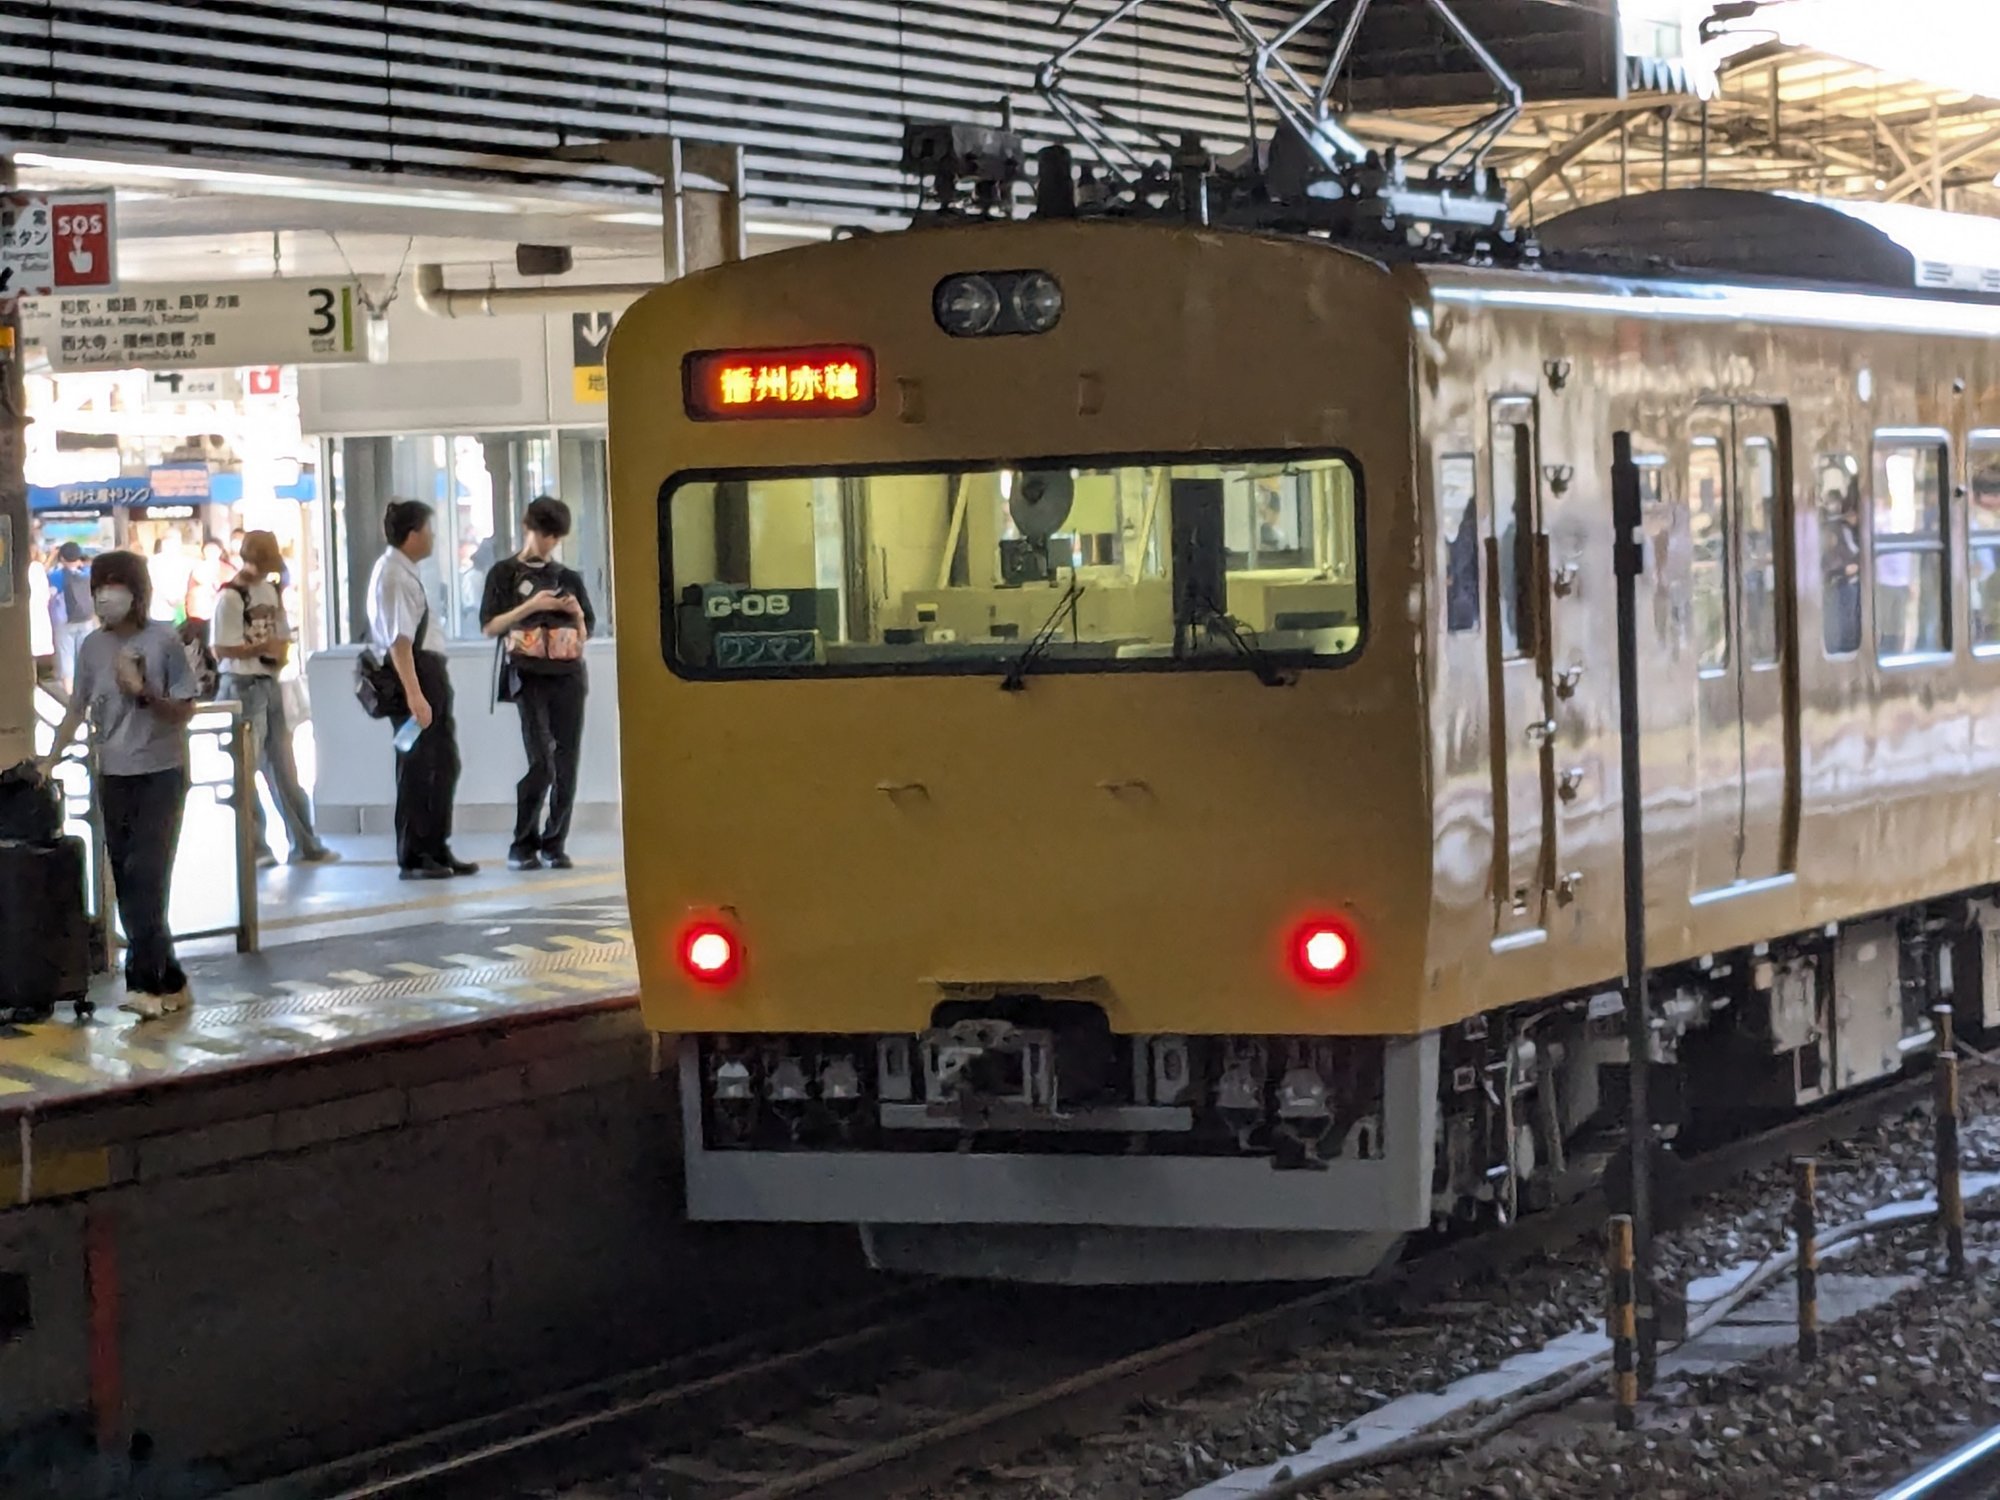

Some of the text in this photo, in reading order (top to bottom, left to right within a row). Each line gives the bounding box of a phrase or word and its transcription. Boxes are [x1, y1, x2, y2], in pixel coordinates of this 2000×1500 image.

[57, 214, 103, 236] SOS
[308, 287, 336, 336] 3
[721, 636, 814, 664] ワンマン
